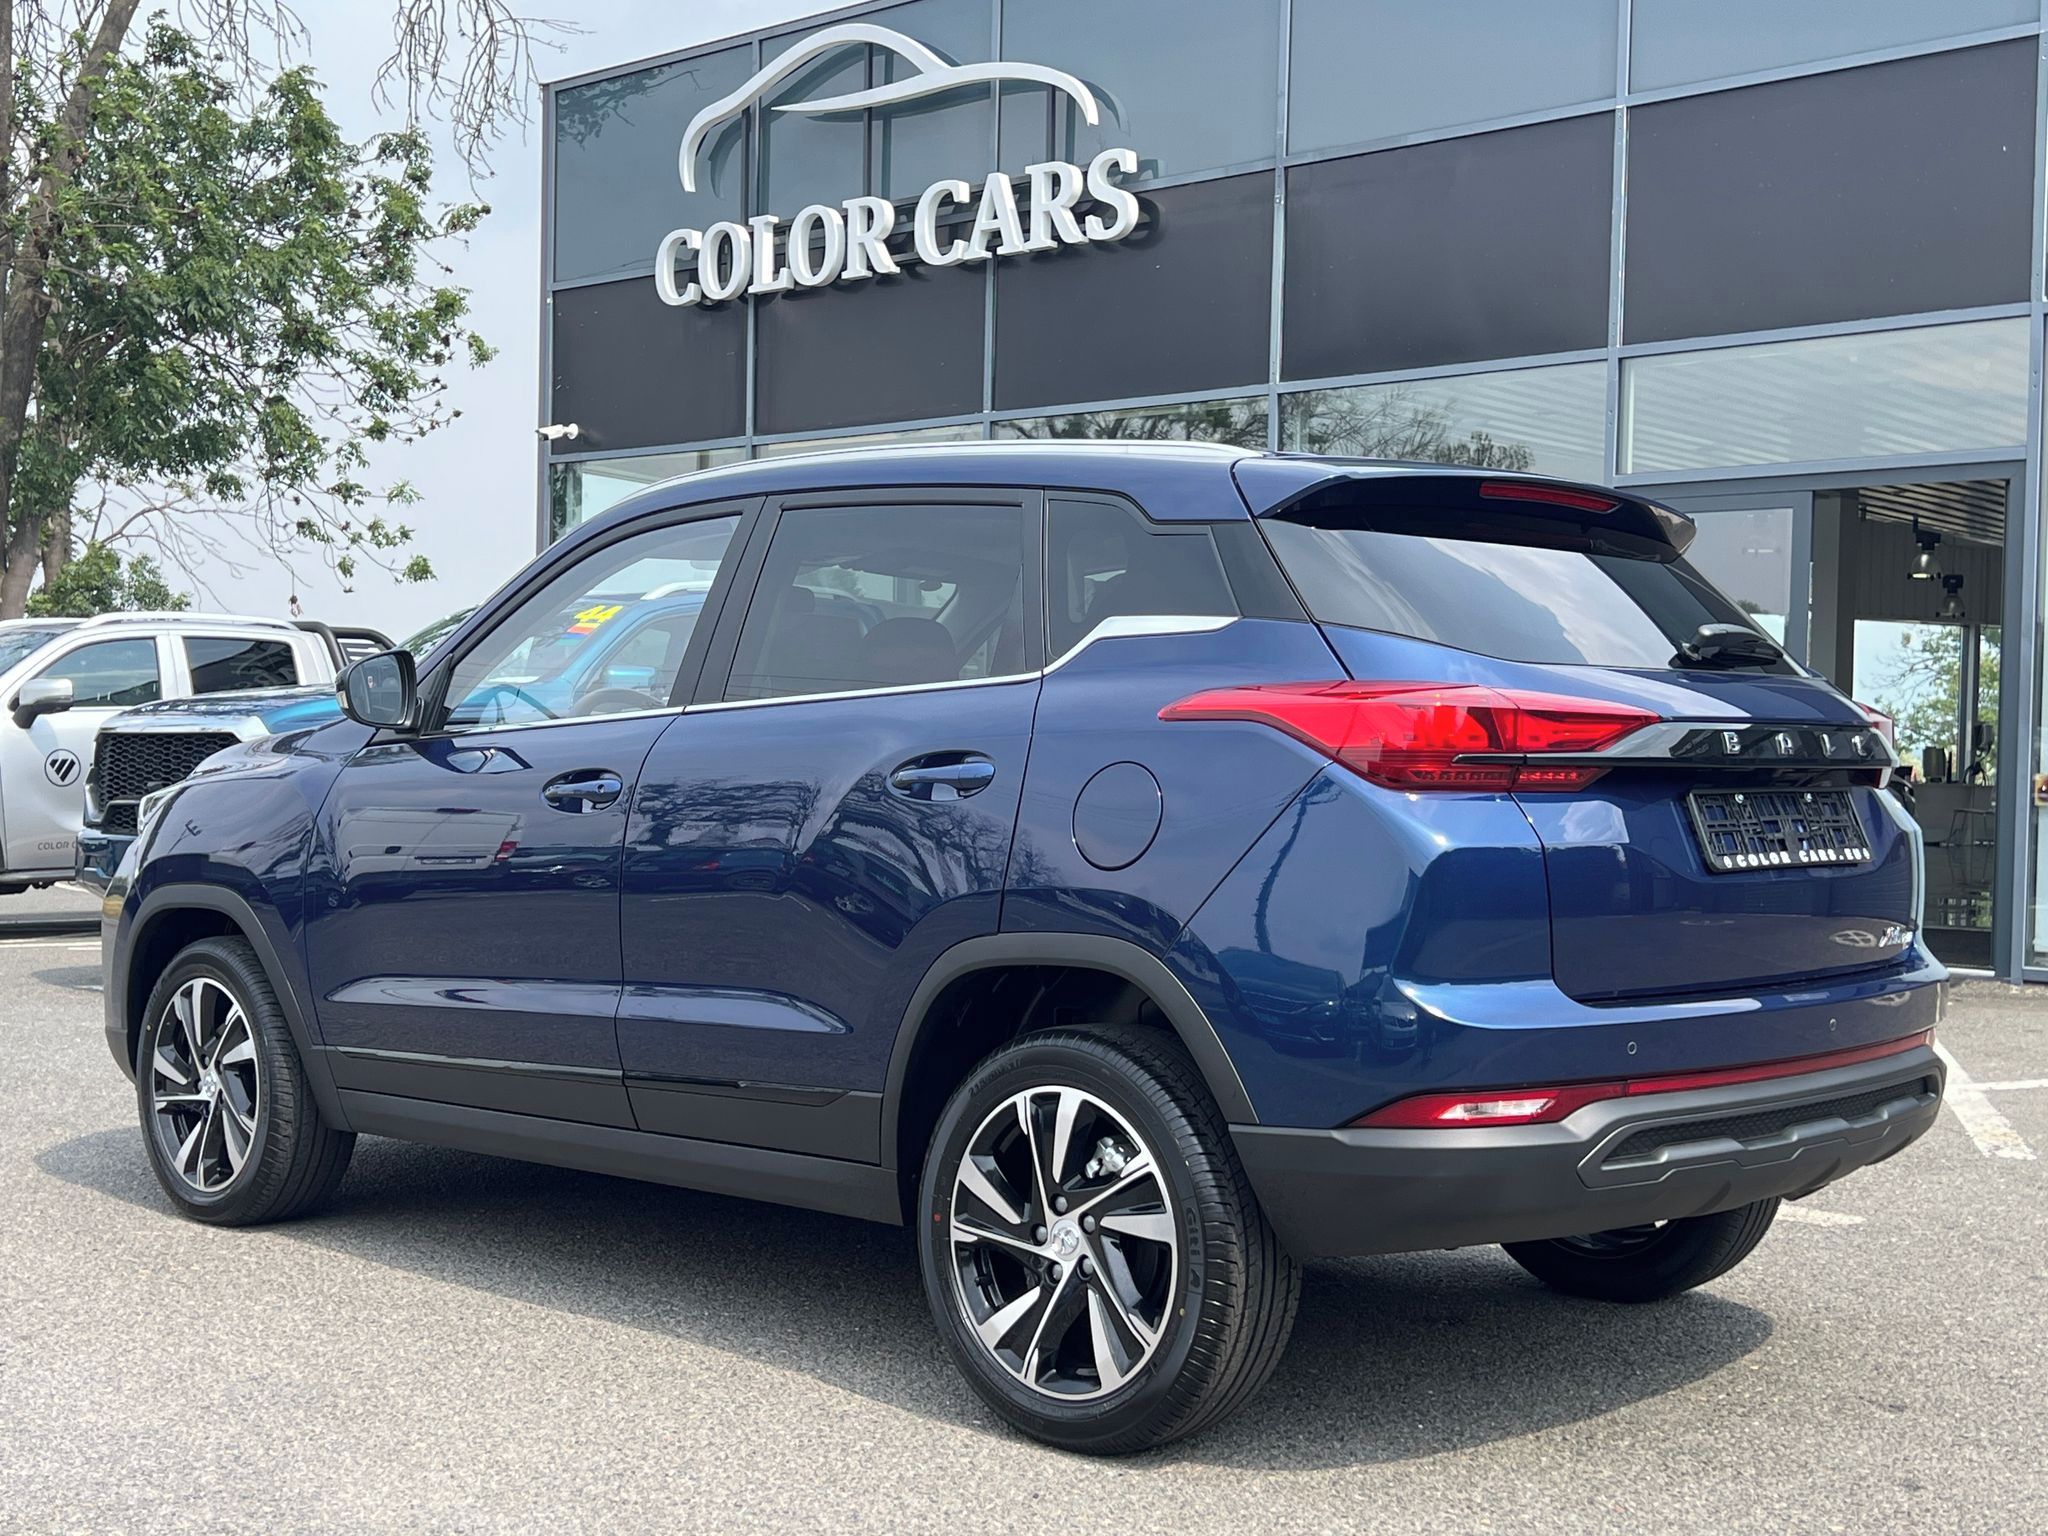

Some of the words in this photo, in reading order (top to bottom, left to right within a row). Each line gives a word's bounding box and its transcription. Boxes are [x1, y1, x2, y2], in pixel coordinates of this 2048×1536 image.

[655, 195, 900, 307] COLOR
[914, 148, 1140, 266] CARS
[37, 841, 70, 851] COLOR
[1736, 851, 1792, 868] COLOR
